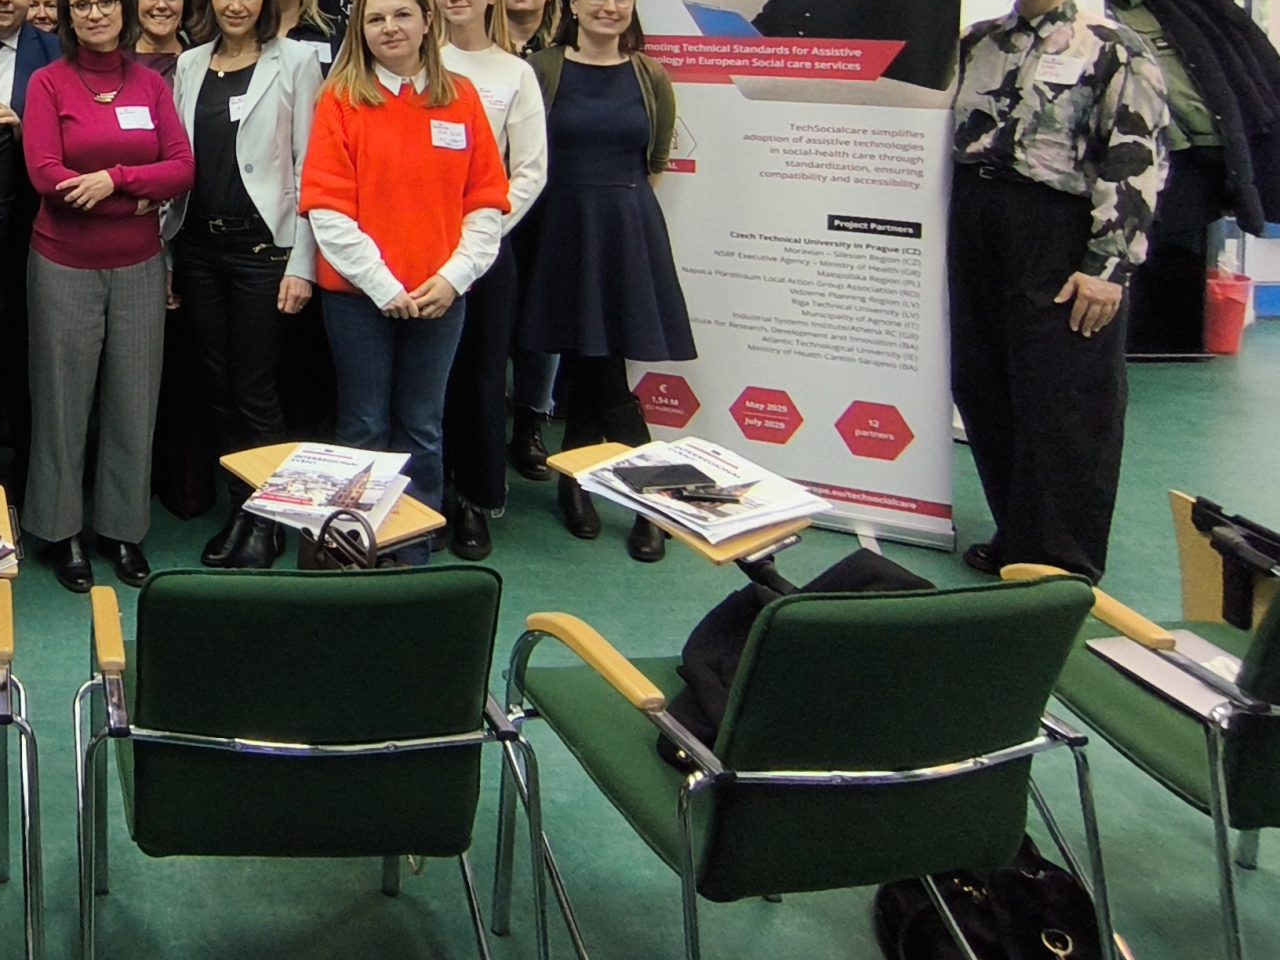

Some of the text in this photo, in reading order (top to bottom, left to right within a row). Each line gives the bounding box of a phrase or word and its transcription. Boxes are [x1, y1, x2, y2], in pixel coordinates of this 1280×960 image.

[644, 43, 863, 58] moting Technical Standards for Assistive
[655, 56, 862, 71] ology in European Social care services
[790, 123, 926, 139] TechSocialcare simplifies
[743, 134, 790, 143] adoption
[805, 138, 852, 146] assistive
[854, 140, 926, 152] technologies
[782, 148, 850, 158] social-health
[852, 152, 876, 160] care
[878, 153, 925, 166] through
[874, 166, 925, 178] ensuring
[759, 171, 828, 182] compatibility
[854, 177, 921, 190] accessibility
[834, 219, 914, 234] Project Partners
[730, 230, 756, 240] Czech
[758, 234, 802, 244] Technical
[804, 238, 852, 250] University
[866, 243, 900, 254] Prague
[902, 247, 922, 256] (CZ)
[746, 400, 764, 411] May
[744, 416, 762, 428] July
[854, 428, 896, 441] partners
